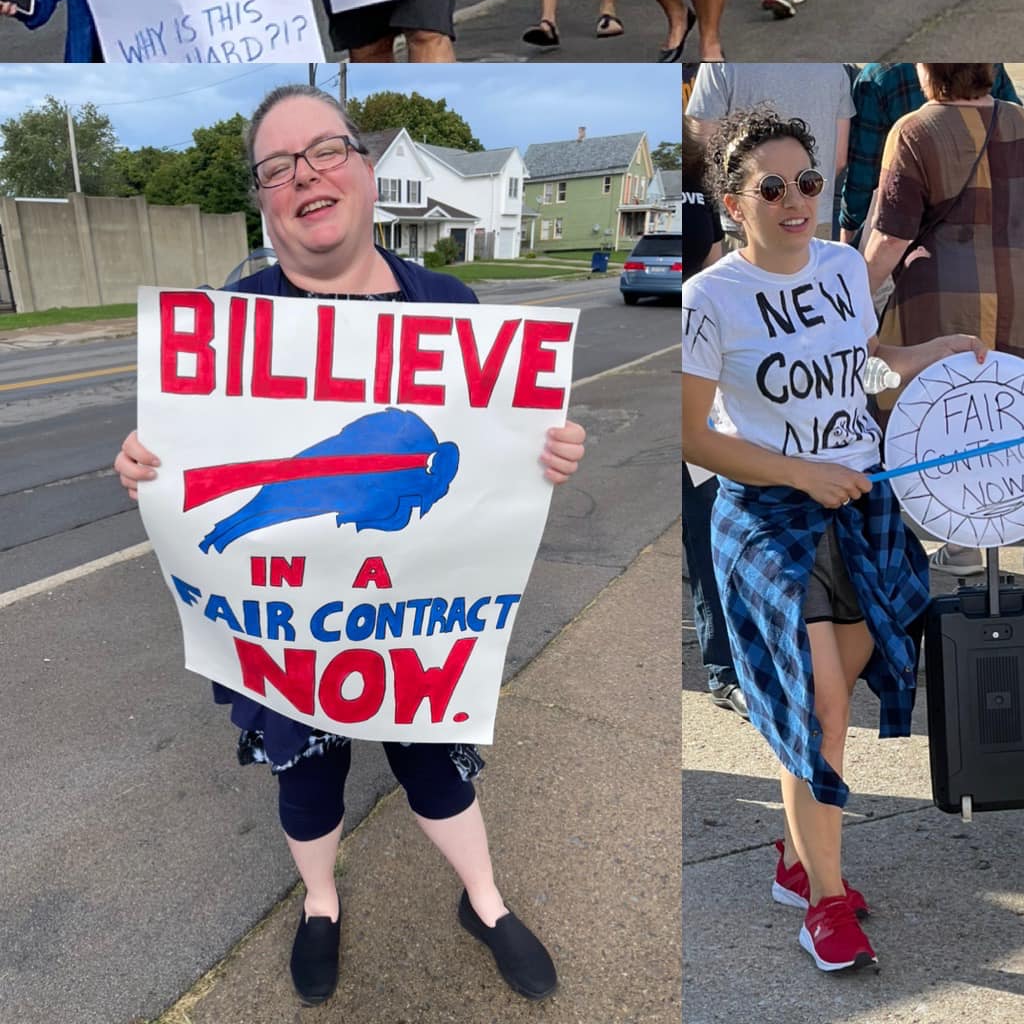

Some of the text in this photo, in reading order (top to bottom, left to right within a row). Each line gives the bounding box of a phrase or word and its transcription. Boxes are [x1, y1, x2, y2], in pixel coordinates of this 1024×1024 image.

[117, 21, 169, 64] WHY
[176, 14, 198, 45] IS
[756, 273, 857, 339] NEW
[159, 291, 573, 410] BILLIEVE
[756, 345, 868, 405] CONTR
[249, 555, 394, 590] IN A
[170, 574, 522, 643] FAIR CONTRACT
[233, 635, 479, 725] NOW.
